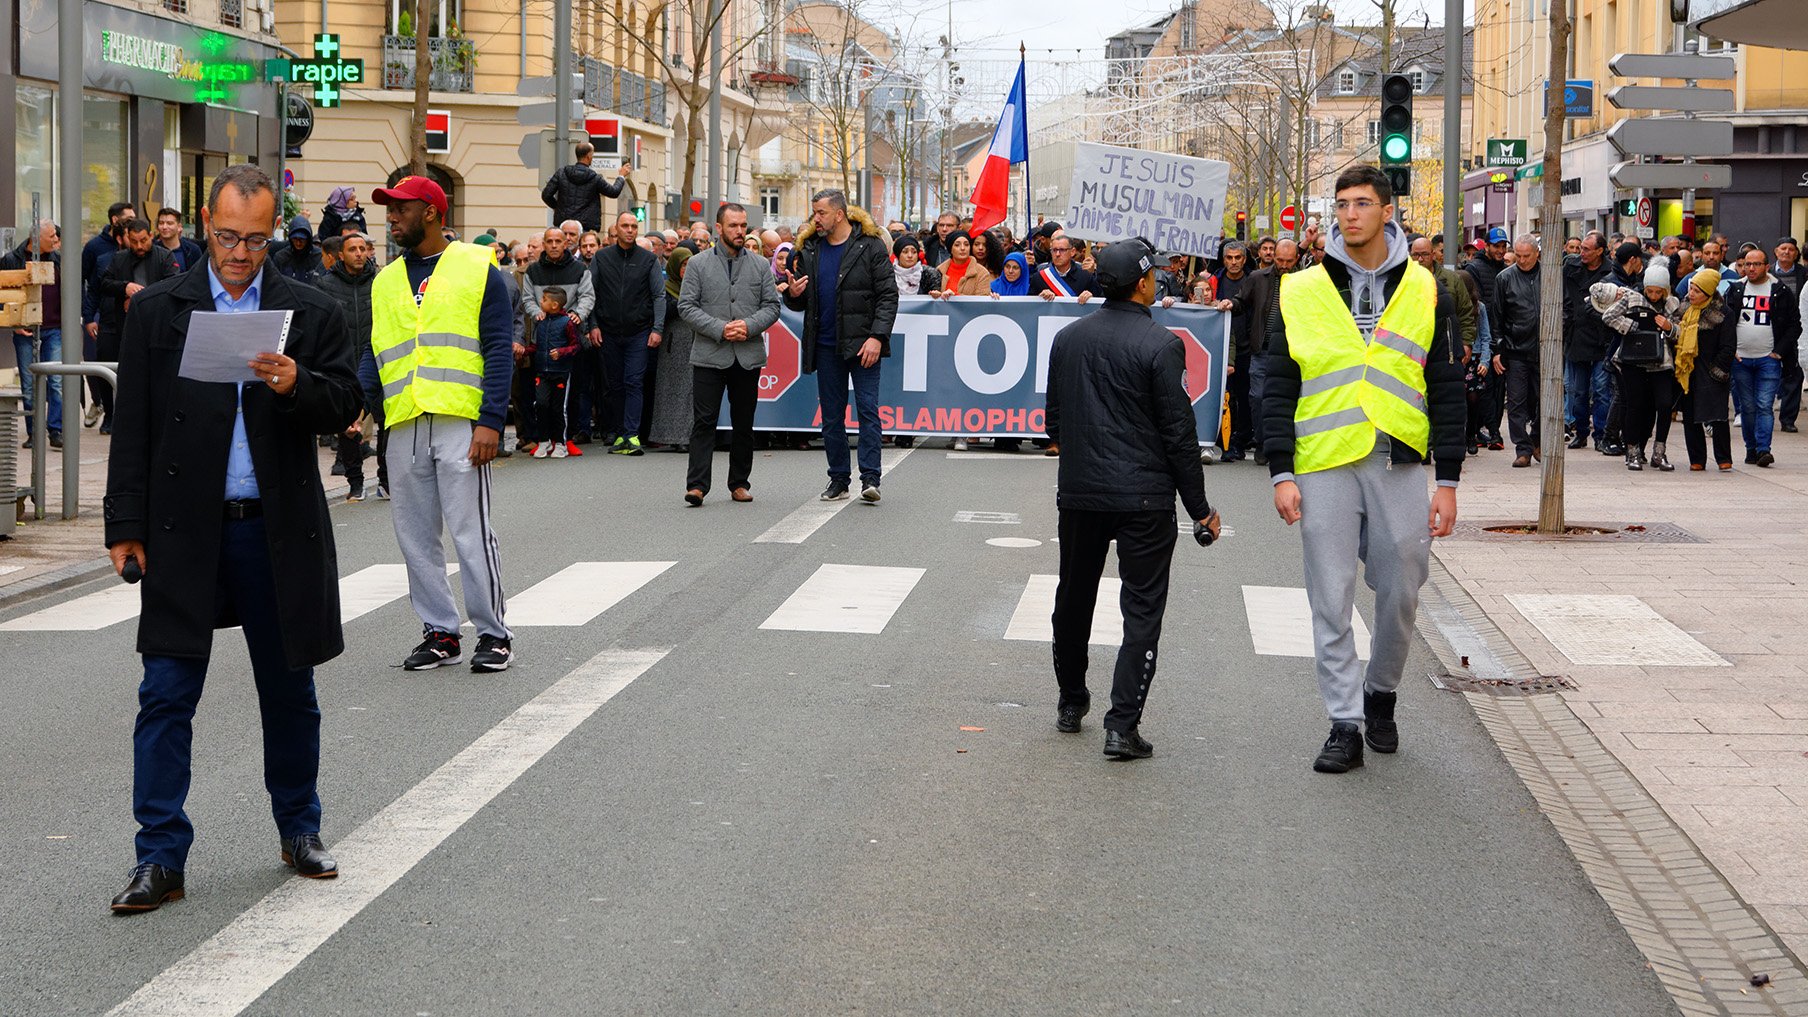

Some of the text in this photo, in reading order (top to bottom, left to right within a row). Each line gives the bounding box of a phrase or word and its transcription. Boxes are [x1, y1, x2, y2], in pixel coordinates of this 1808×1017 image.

[292, 59, 359, 84] rapie
[1100, 153, 1133, 180] JE
[1490, 156, 1524, 165] MEPHISTO
[1080, 181, 1214, 221] MUSULMAN
[1154, 218, 1220, 257] FRANCE
[758, 375, 778, 390] OP
